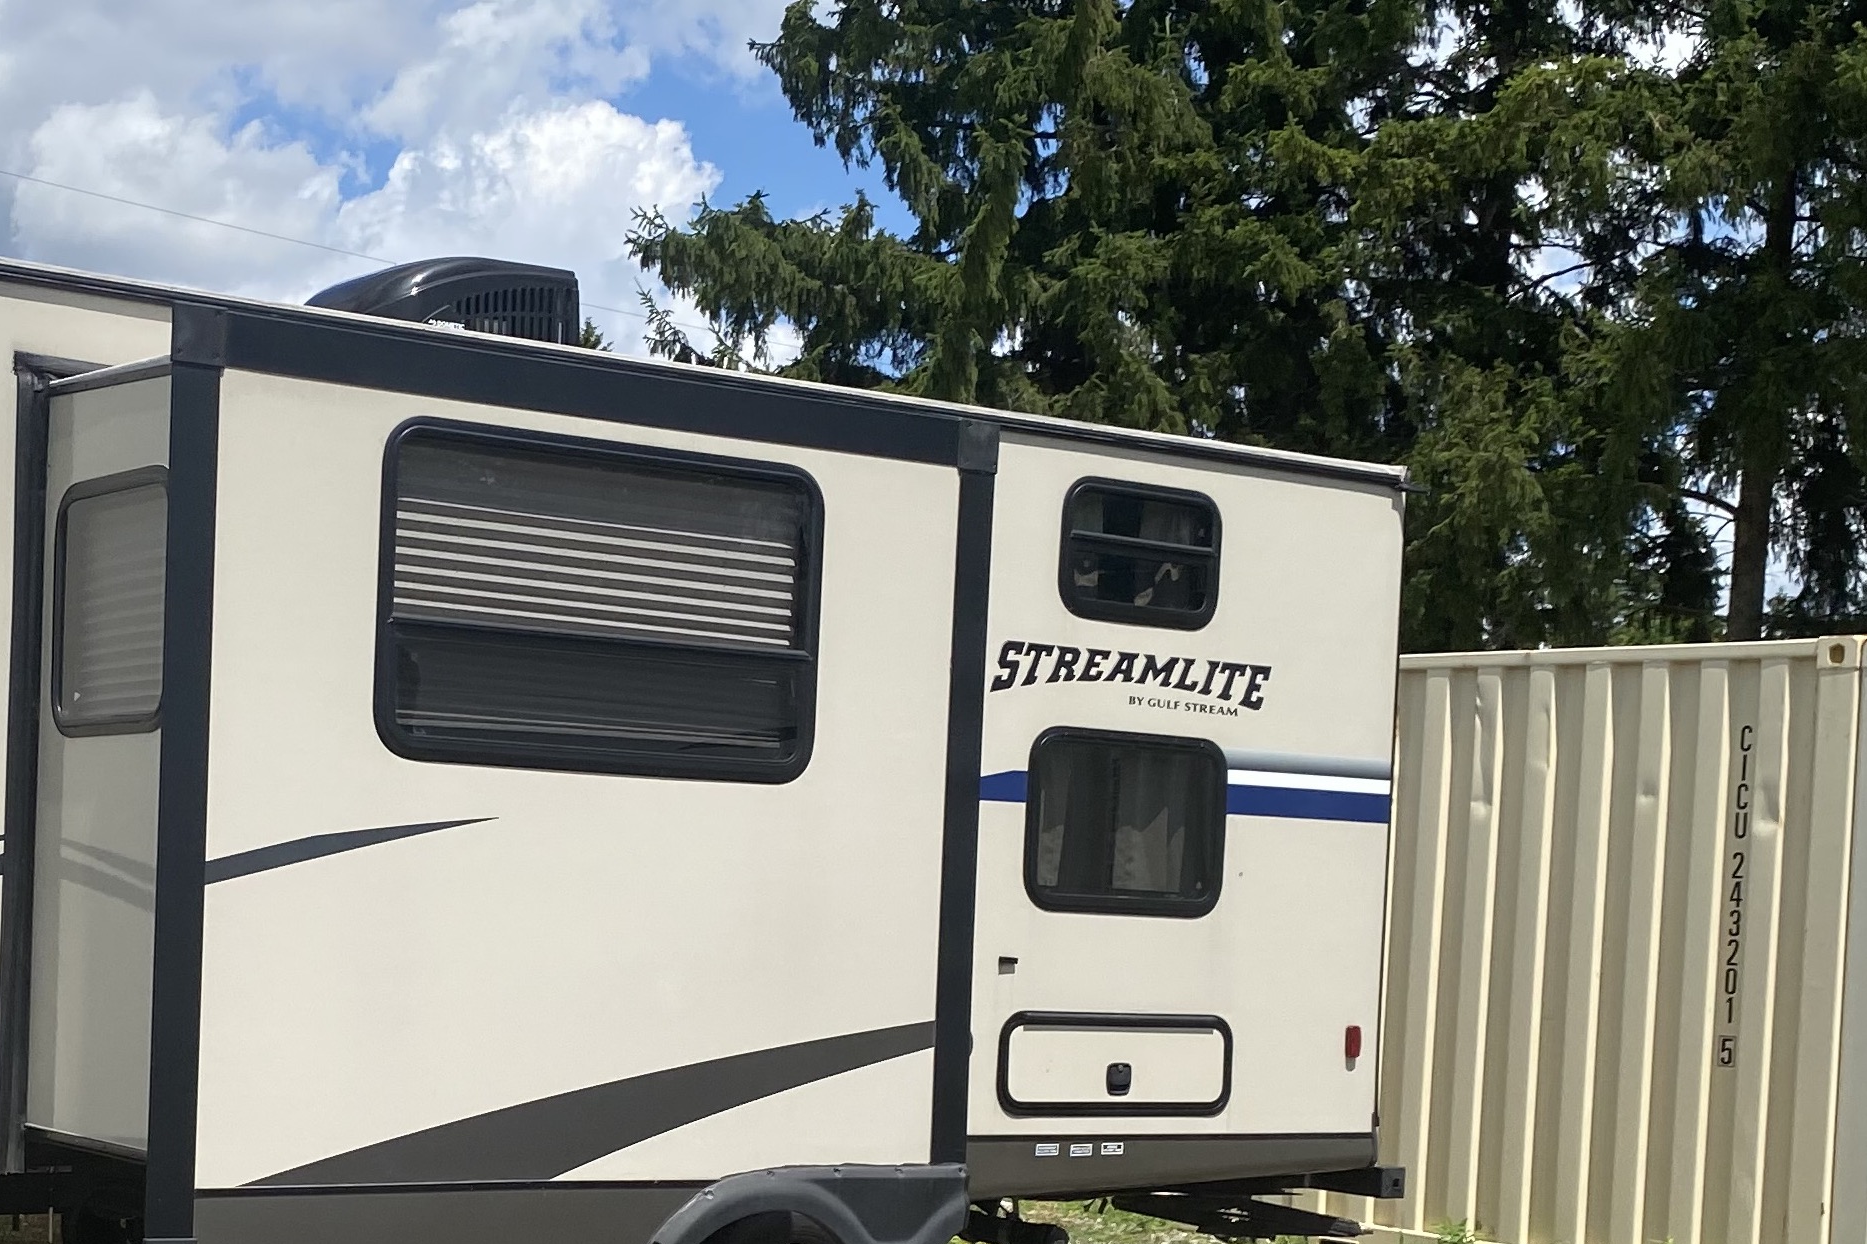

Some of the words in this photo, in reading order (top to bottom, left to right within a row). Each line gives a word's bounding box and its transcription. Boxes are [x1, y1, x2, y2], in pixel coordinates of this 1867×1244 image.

[990, 640, 1272, 711] STREAMLITE
[1128, 695, 1145, 706] BY
[1147, 698, 1181, 710] GULF
[1184, 702, 1239, 717] STREAM
[1734, 725, 1752, 839] CICU
[1724, 852, 1744, 1024] 243201
[1719, 1038, 1734, 1065] 5
